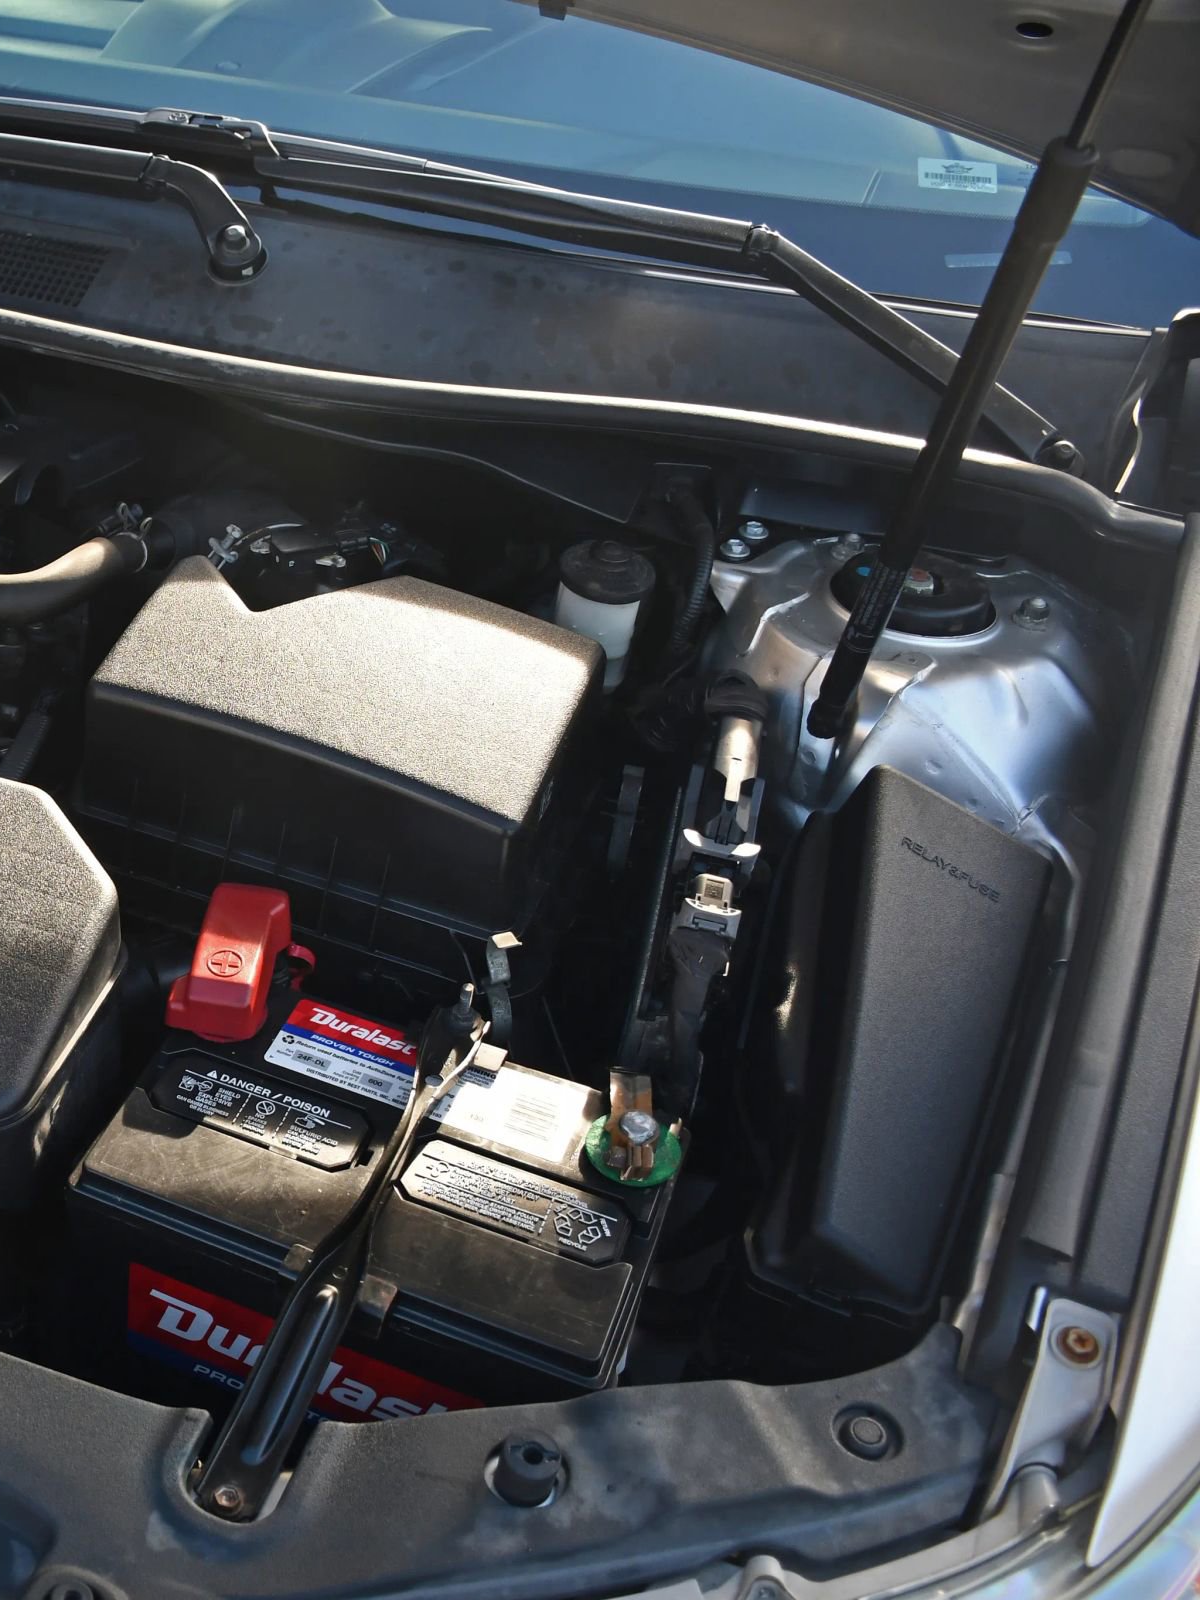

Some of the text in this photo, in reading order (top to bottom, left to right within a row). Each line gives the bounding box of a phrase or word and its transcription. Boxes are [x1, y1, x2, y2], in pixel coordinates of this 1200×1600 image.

[309, 1007, 417, 1055] Duralast
[297, 1053, 326, 1068] 24F-DL
[310, 1034, 395, 1067] PROVEN TOUGH
[198, 1092, 232, 1107] EXPLOSIVE
[220, 1074, 272, 1097] DANGER
[282, 1095, 331, 1118] POISON
[289, 1125, 322, 1141] SULFURIC
[321, 1137, 338, 1147] ACID
[559, 1237, 588, 1252] RECYCLE
[192, 1363, 245, 1390] PRO
